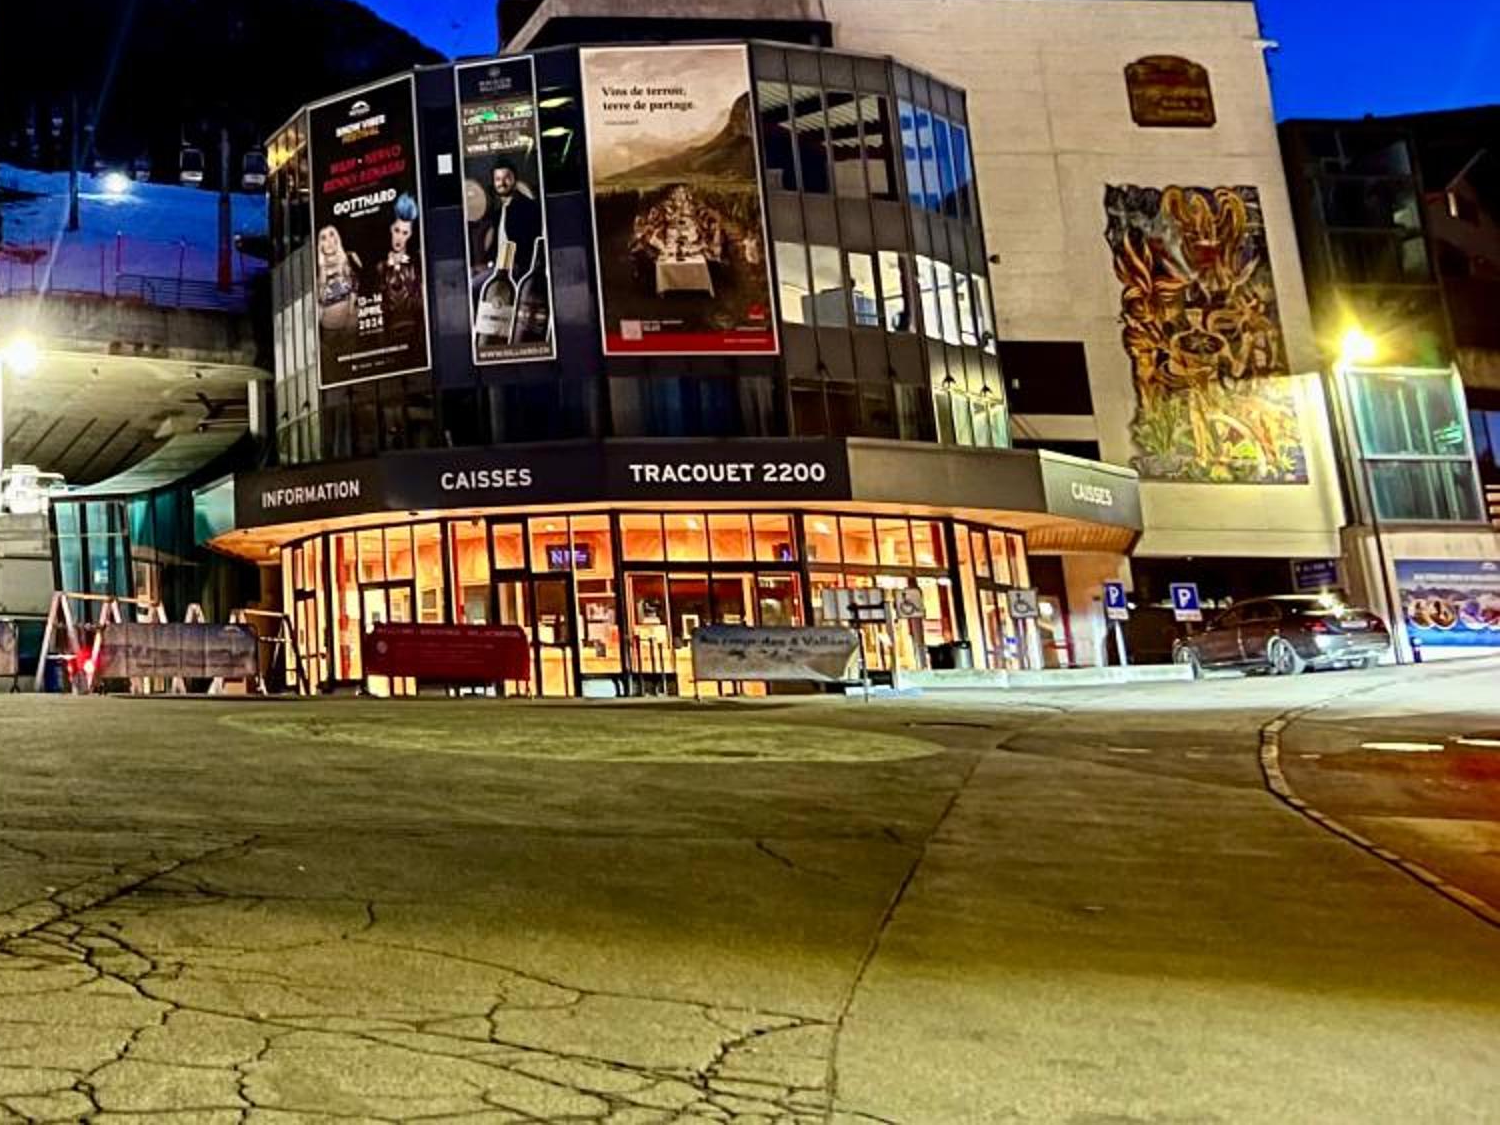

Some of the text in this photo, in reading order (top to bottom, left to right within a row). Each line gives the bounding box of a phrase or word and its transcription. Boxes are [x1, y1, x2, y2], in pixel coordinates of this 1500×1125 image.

[602, 85, 687, 97] Vins de terroir,
[603, 102, 630, 111] terre
[633, 100, 646, 110] de
[333, 188, 397, 215] GOTTHARD
[359, 316, 384, 330] 2024
[440, 468, 533, 490] CAISSES
[629, 463, 826, 482] TRACOUET 2200
[261, 479, 361, 508] INFORMATION
[1071, 481, 1113, 507] CAISSES
[1109, 586, 1119, 606] P
[1177, 588, 1191, 608] P
